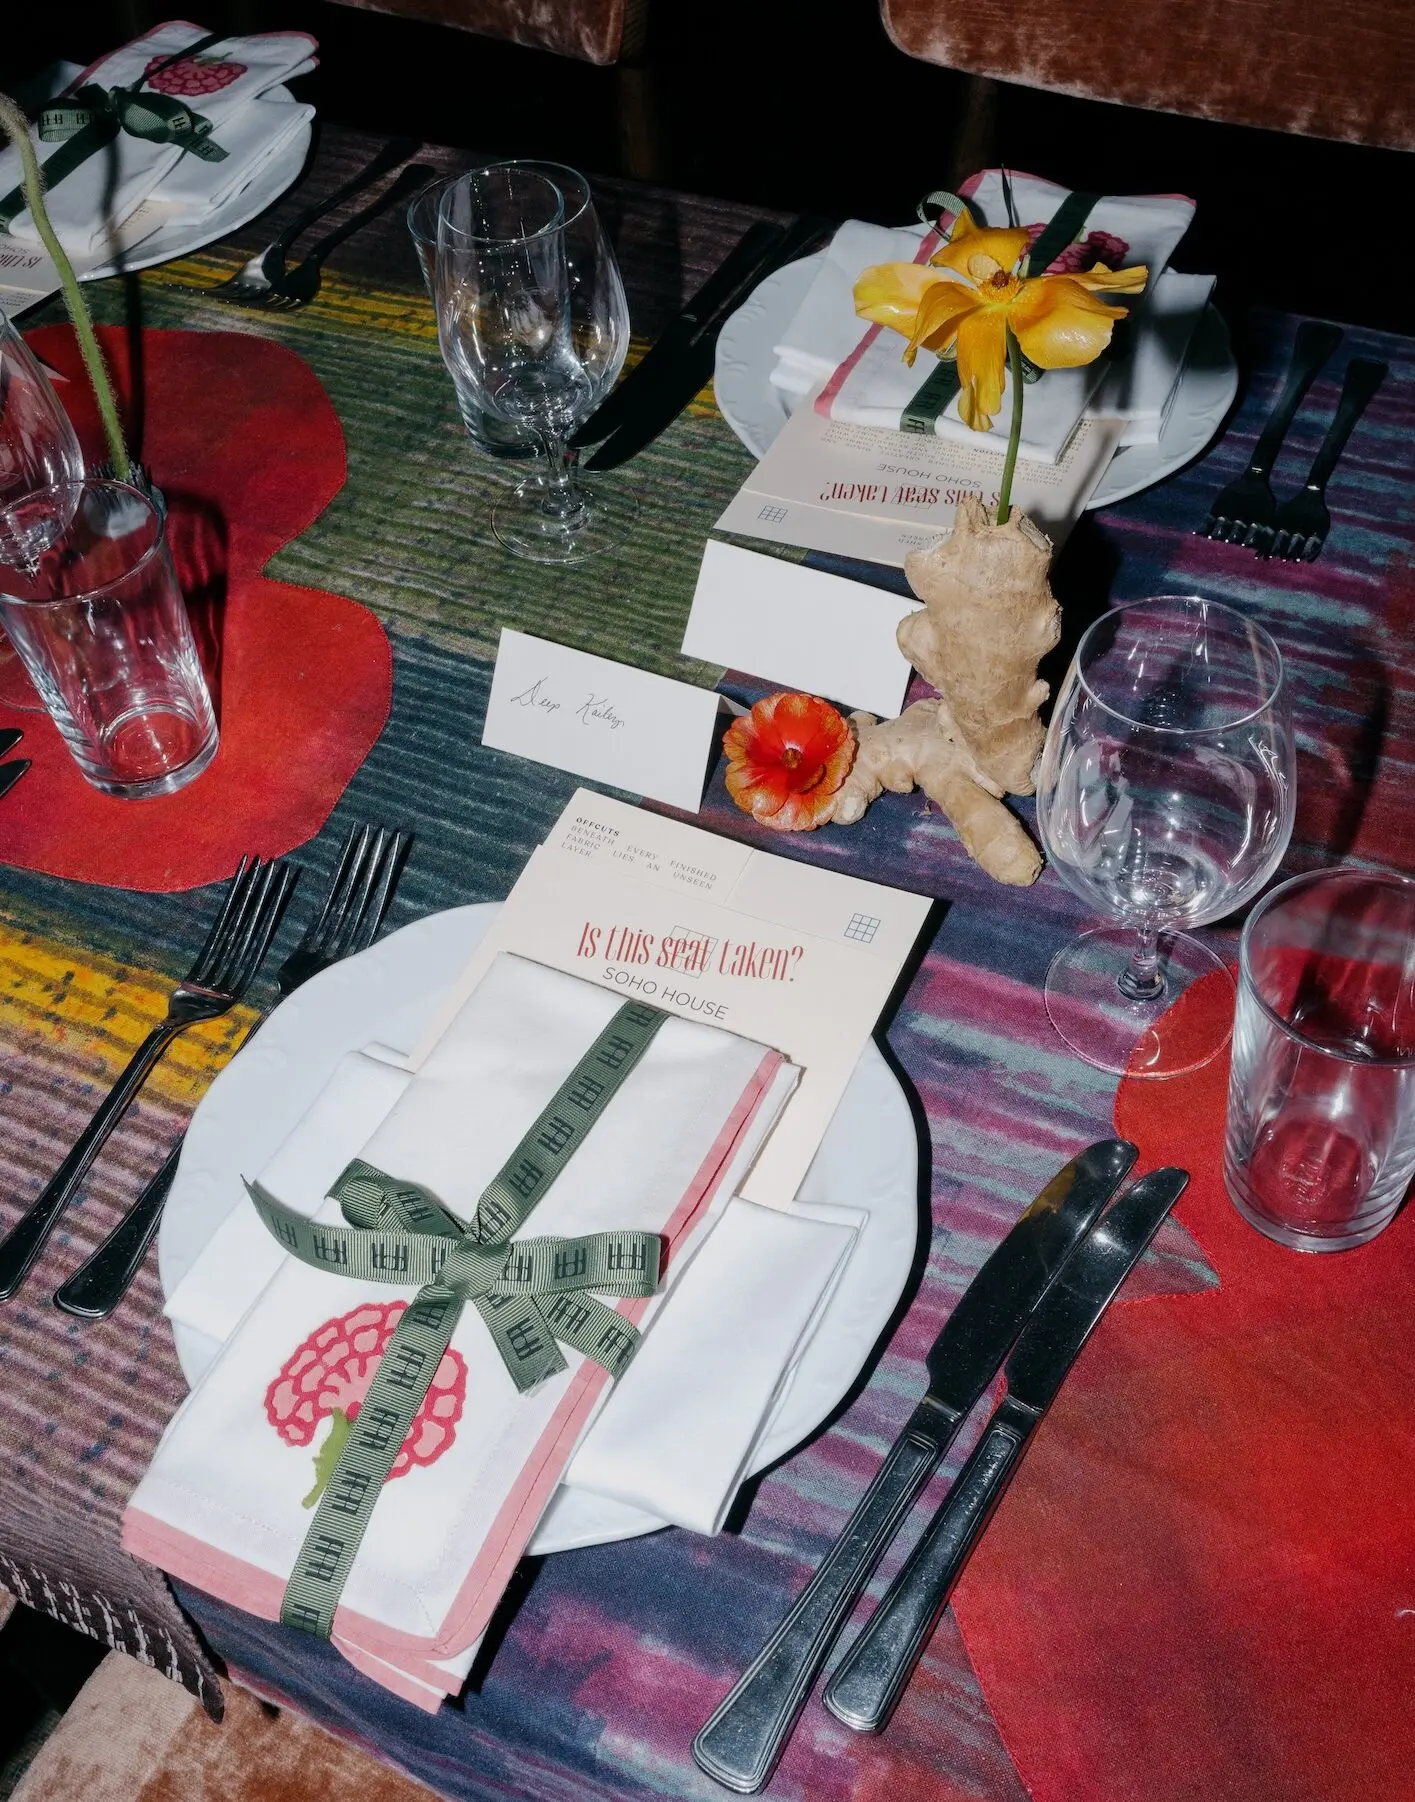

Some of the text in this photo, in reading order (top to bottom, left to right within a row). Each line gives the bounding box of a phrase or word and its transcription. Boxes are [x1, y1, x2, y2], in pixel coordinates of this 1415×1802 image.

[820, 482, 888, 503] taken?
[875, 464, 982, 489] SOHO HOUSE
[898, 486, 941, 505] seat
[576, 816, 620, 837] OFFCUTS
[566, 833, 713, 890] FABRIC LIES AN UNSEEN
[570, 825, 717, 882] BENEATH EVERY FINISHED
[576, 921, 804, 982] Is this seat taken?
[602, 967, 658, 995] SOHO
[661, 986, 730, 1021] HOUSE
